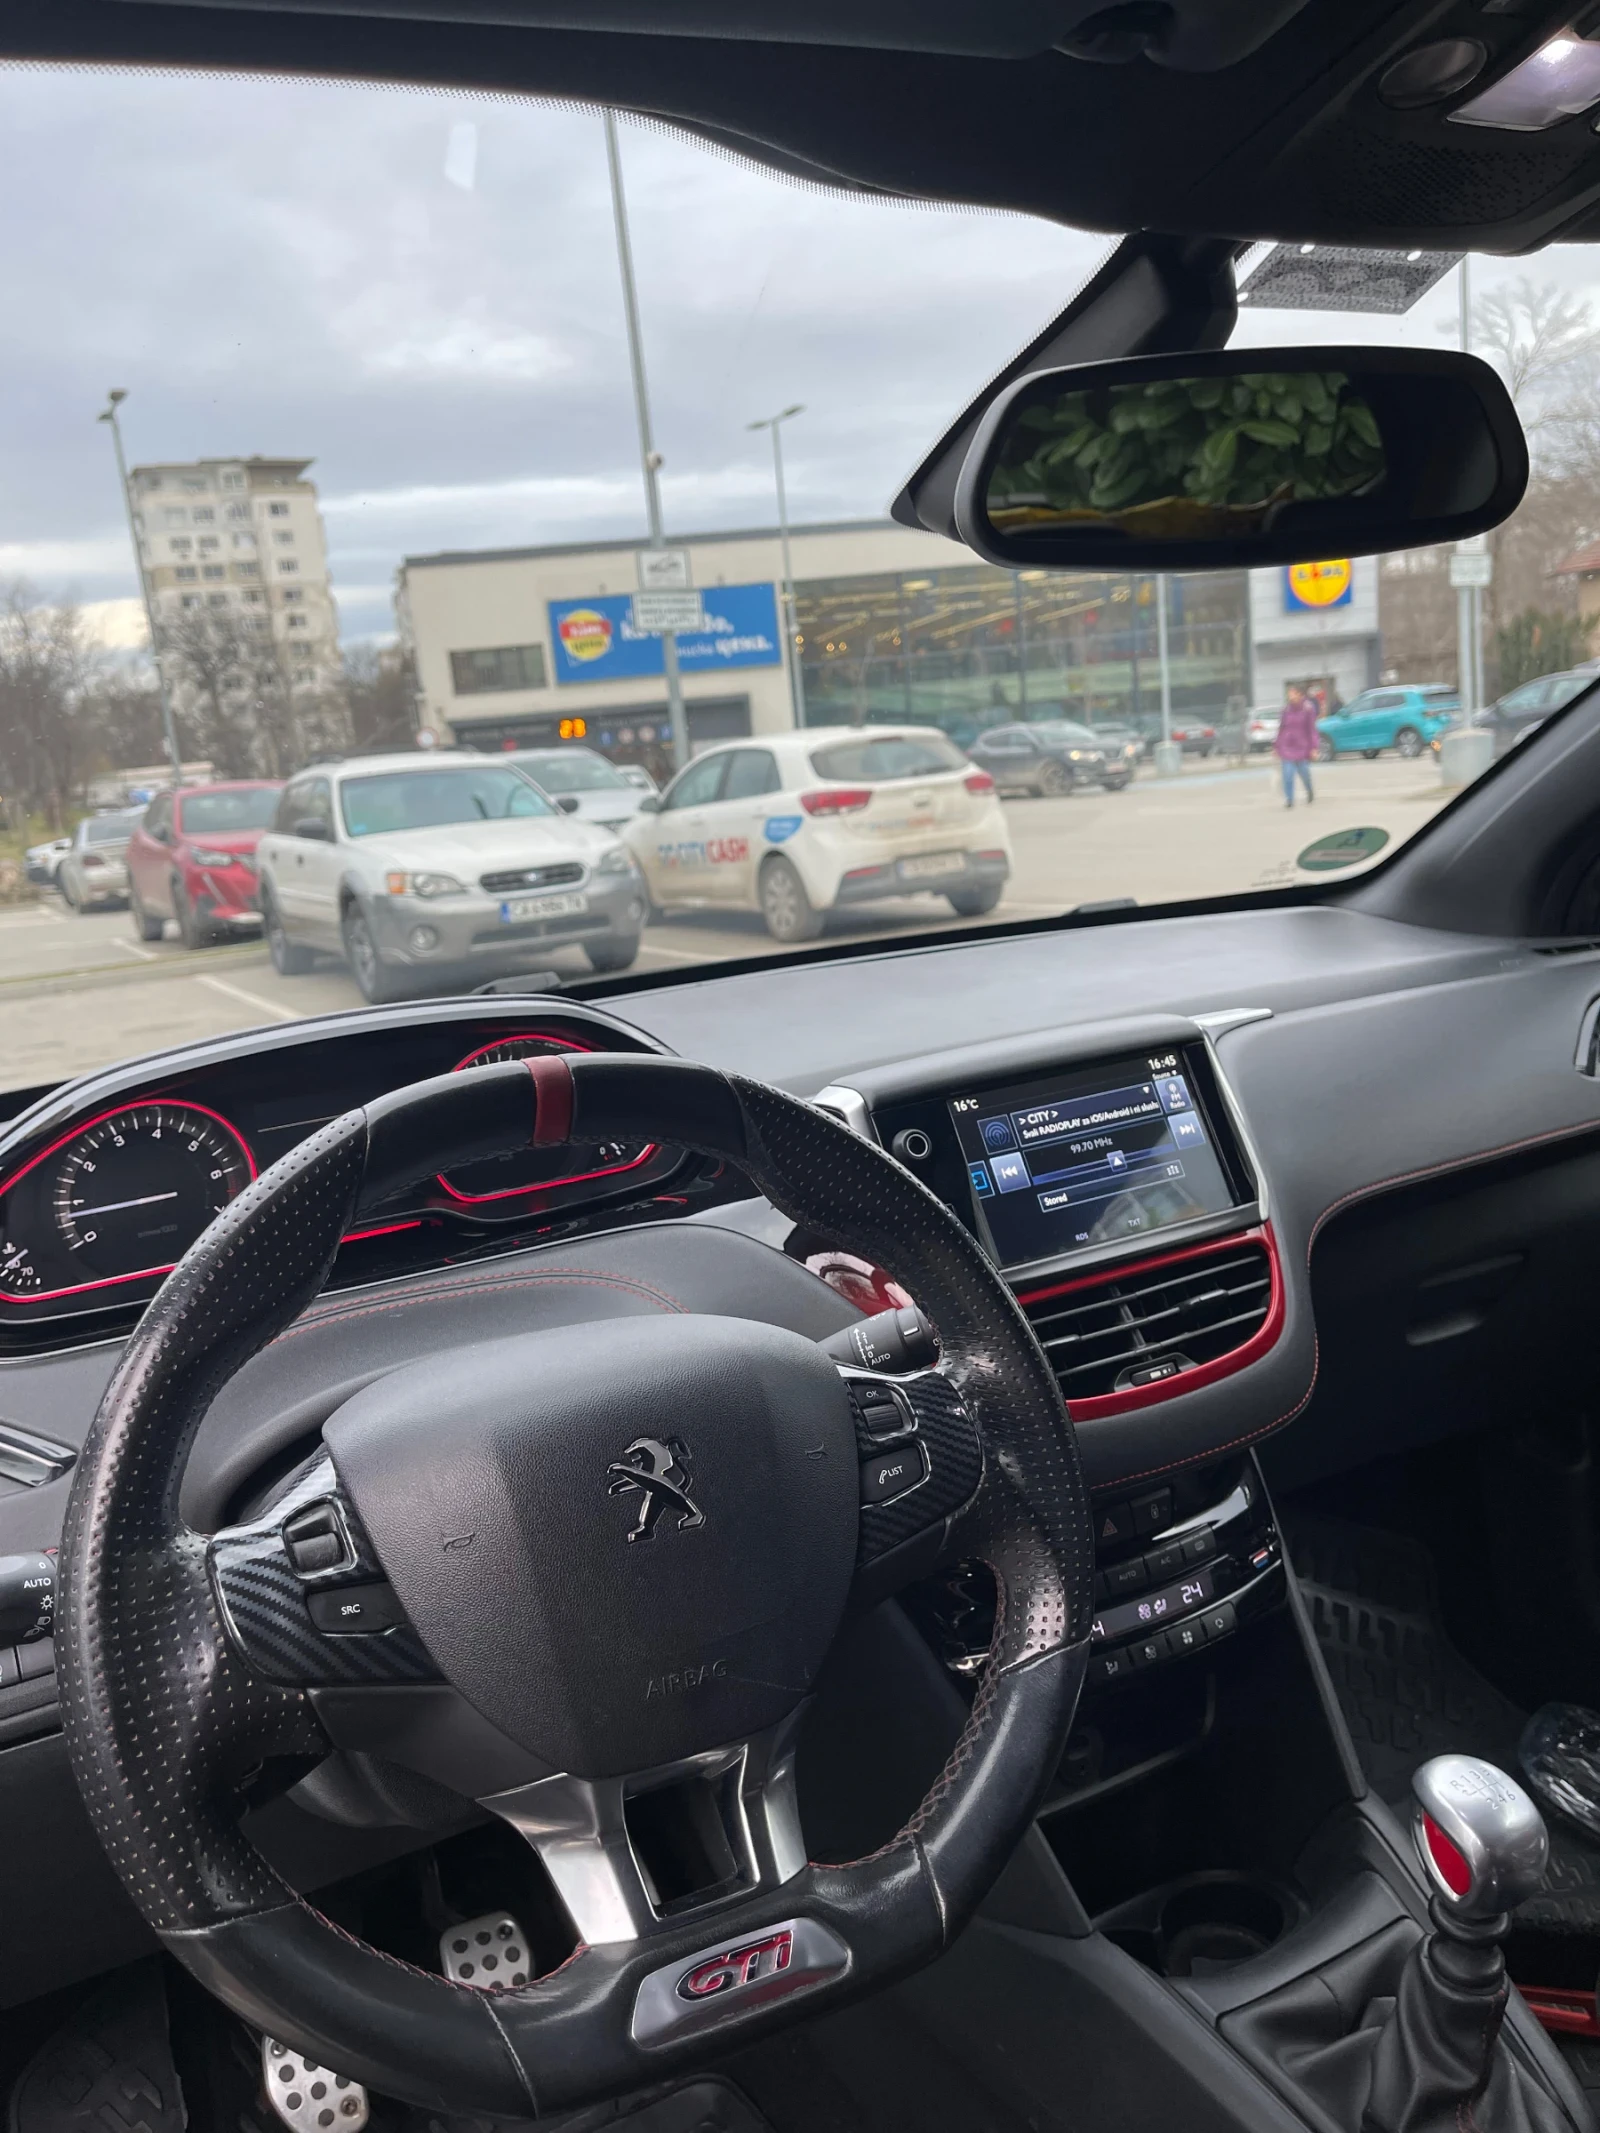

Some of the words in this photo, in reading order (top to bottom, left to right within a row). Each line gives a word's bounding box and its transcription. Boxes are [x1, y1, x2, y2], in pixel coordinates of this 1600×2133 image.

[1148, 1055, 1177, 1070] 16:45
[1170, 1093, 1181, 1101] FM
[953, 1098, 979, 1112] 16°C
[1170, 1101, 1186, 1109] Radio
[1027, 1110, 1050, 1124] CITY
[1038, 1118, 1081, 1136] RADIOPLAY
[152, 1129, 162, 1139] 4
[113, 1137, 125, 1147] 3
[187, 1140, 200, 1152] 5
[1070, 1140, 1093, 1154] 99.70
[1094, 1137, 1113, 1149] MHz
[83, 1161, 97, 1172] 2
[210, 1169, 222, 1180] 6
[73, 1197, 84, 1206] 1
[1043, 1193, 1068, 1207] Stored
[1127, 1218, 1141, 1227] TXT
[84, 1230, 97, 1243] 0
[1075, 1232, 1089, 1241] RDS
[20, 1266, 34, 1277] 70
[864, 1343, 875, 1351] Int
[867, 1350, 874, 1358] 0
[871, 1353, 891, 1366] AUTO
[866, 1390, 879, 1398] OK
[887, 1465, 903, 1476] LIST
[1160, 1557, 1171, 1565] A/C
[1118, 1570, 1137, 1581] AUTO
[23, 1577, 52, 1589] AUTO
[1180, 1582, 1204, 1604] 24
[340, 1603, 361, 1615] SRC
[646, 1659, 728, 1700] AIRBAG
[1450, 1780, 1464, 1789] R
[1486, 1797, 1499, 1810] 2
